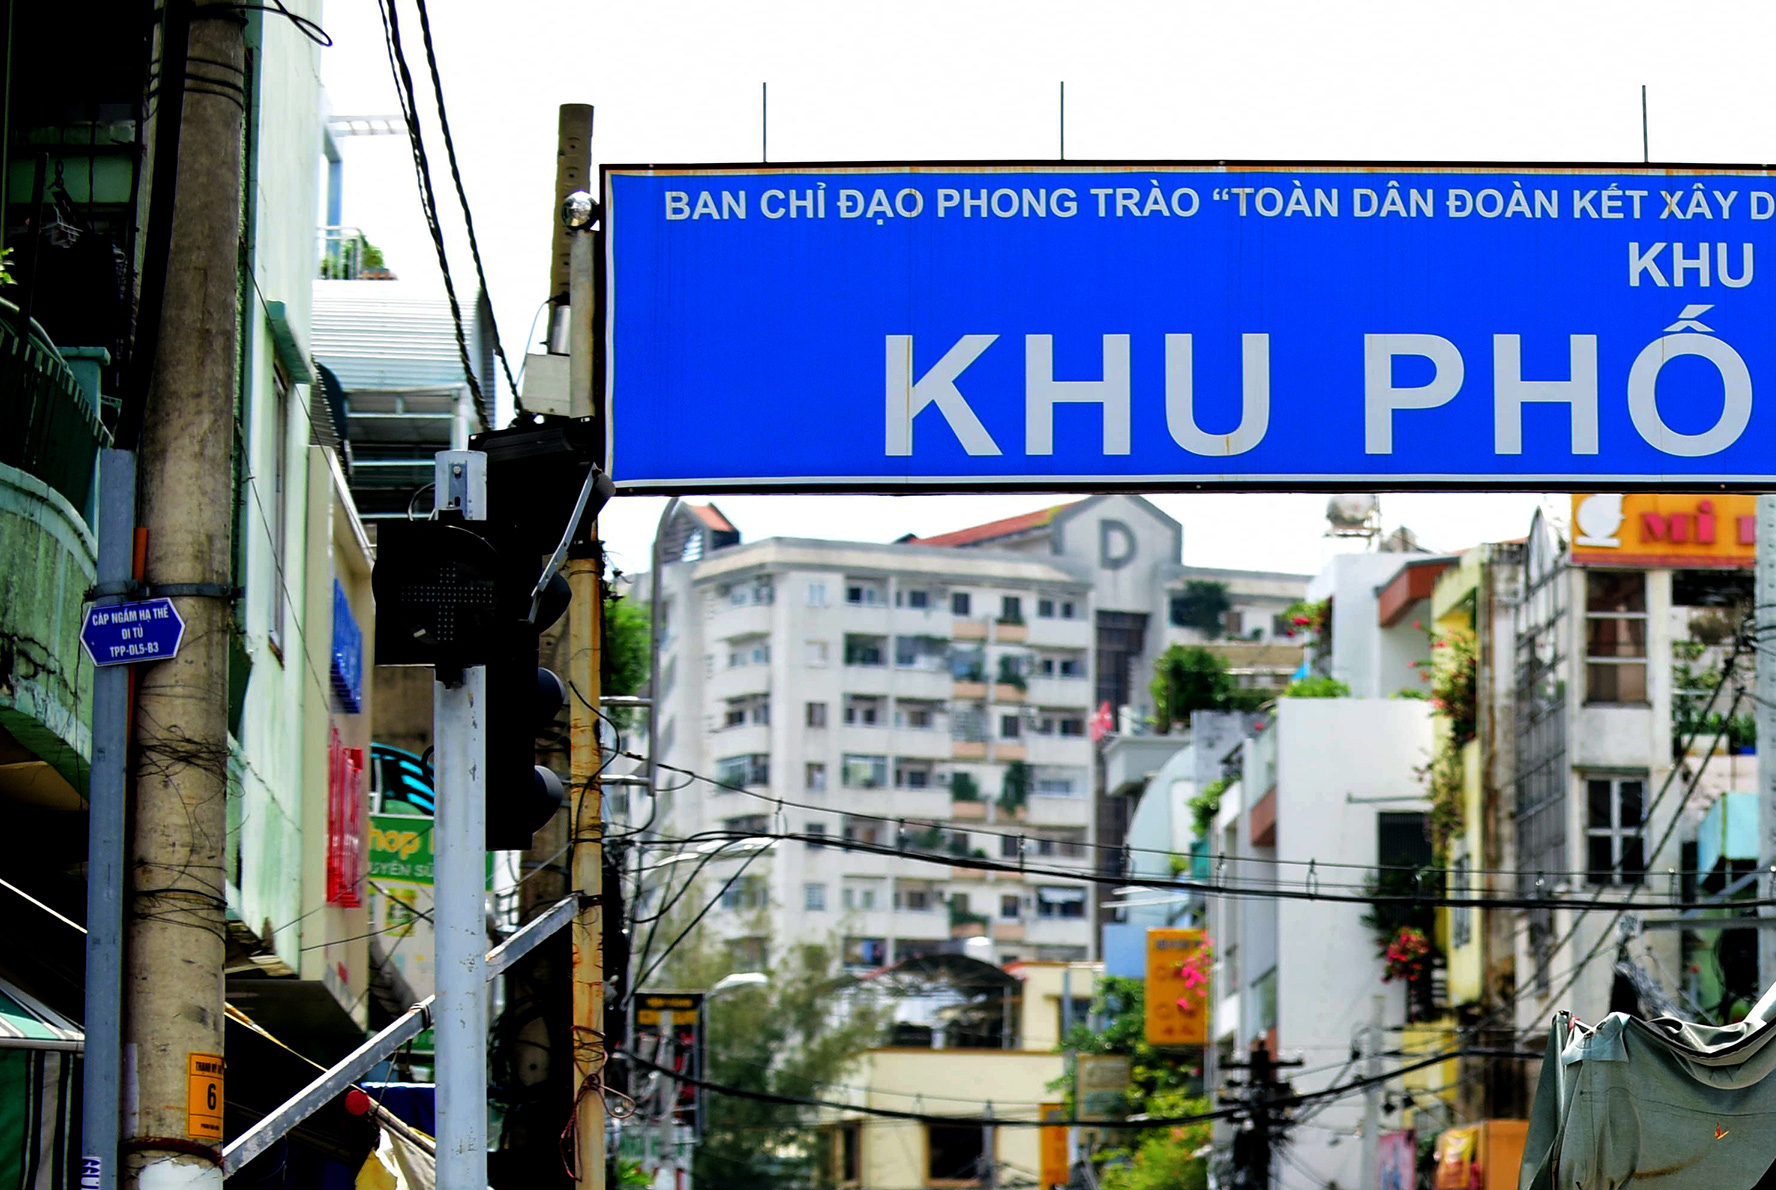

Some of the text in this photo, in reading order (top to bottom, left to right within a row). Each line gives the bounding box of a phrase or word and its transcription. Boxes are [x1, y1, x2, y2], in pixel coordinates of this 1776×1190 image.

[665, 190, 747, 219] BAN
[760, 184, 826, 219] CHỈ
[837, 189, 923, 225] ĐẠO
[937, 189, 1077, 218] PHONG
[1090, 180, 1200, 218] TRÀO
[1353, 181, 1435, 218] DÂN
[1446, 181, 1562, 219] ĐOÀN
[1574, 184, 1648, 219] KẾT
[1660, 185, 1735, 221] XÂY
[1630, 242, 1753, 287] KHU
[886, 334, 1269, 456] KHU
[1365, 305, 1752, 456] PHỐ
[1100, 519, 1136, 570] D
[132, 623, 144, 639] TỦ
[139, 608, 152, 623] HẠ
[152, 604, 170, 620] THẾ
[207, 1083, 217, 1110] 6
